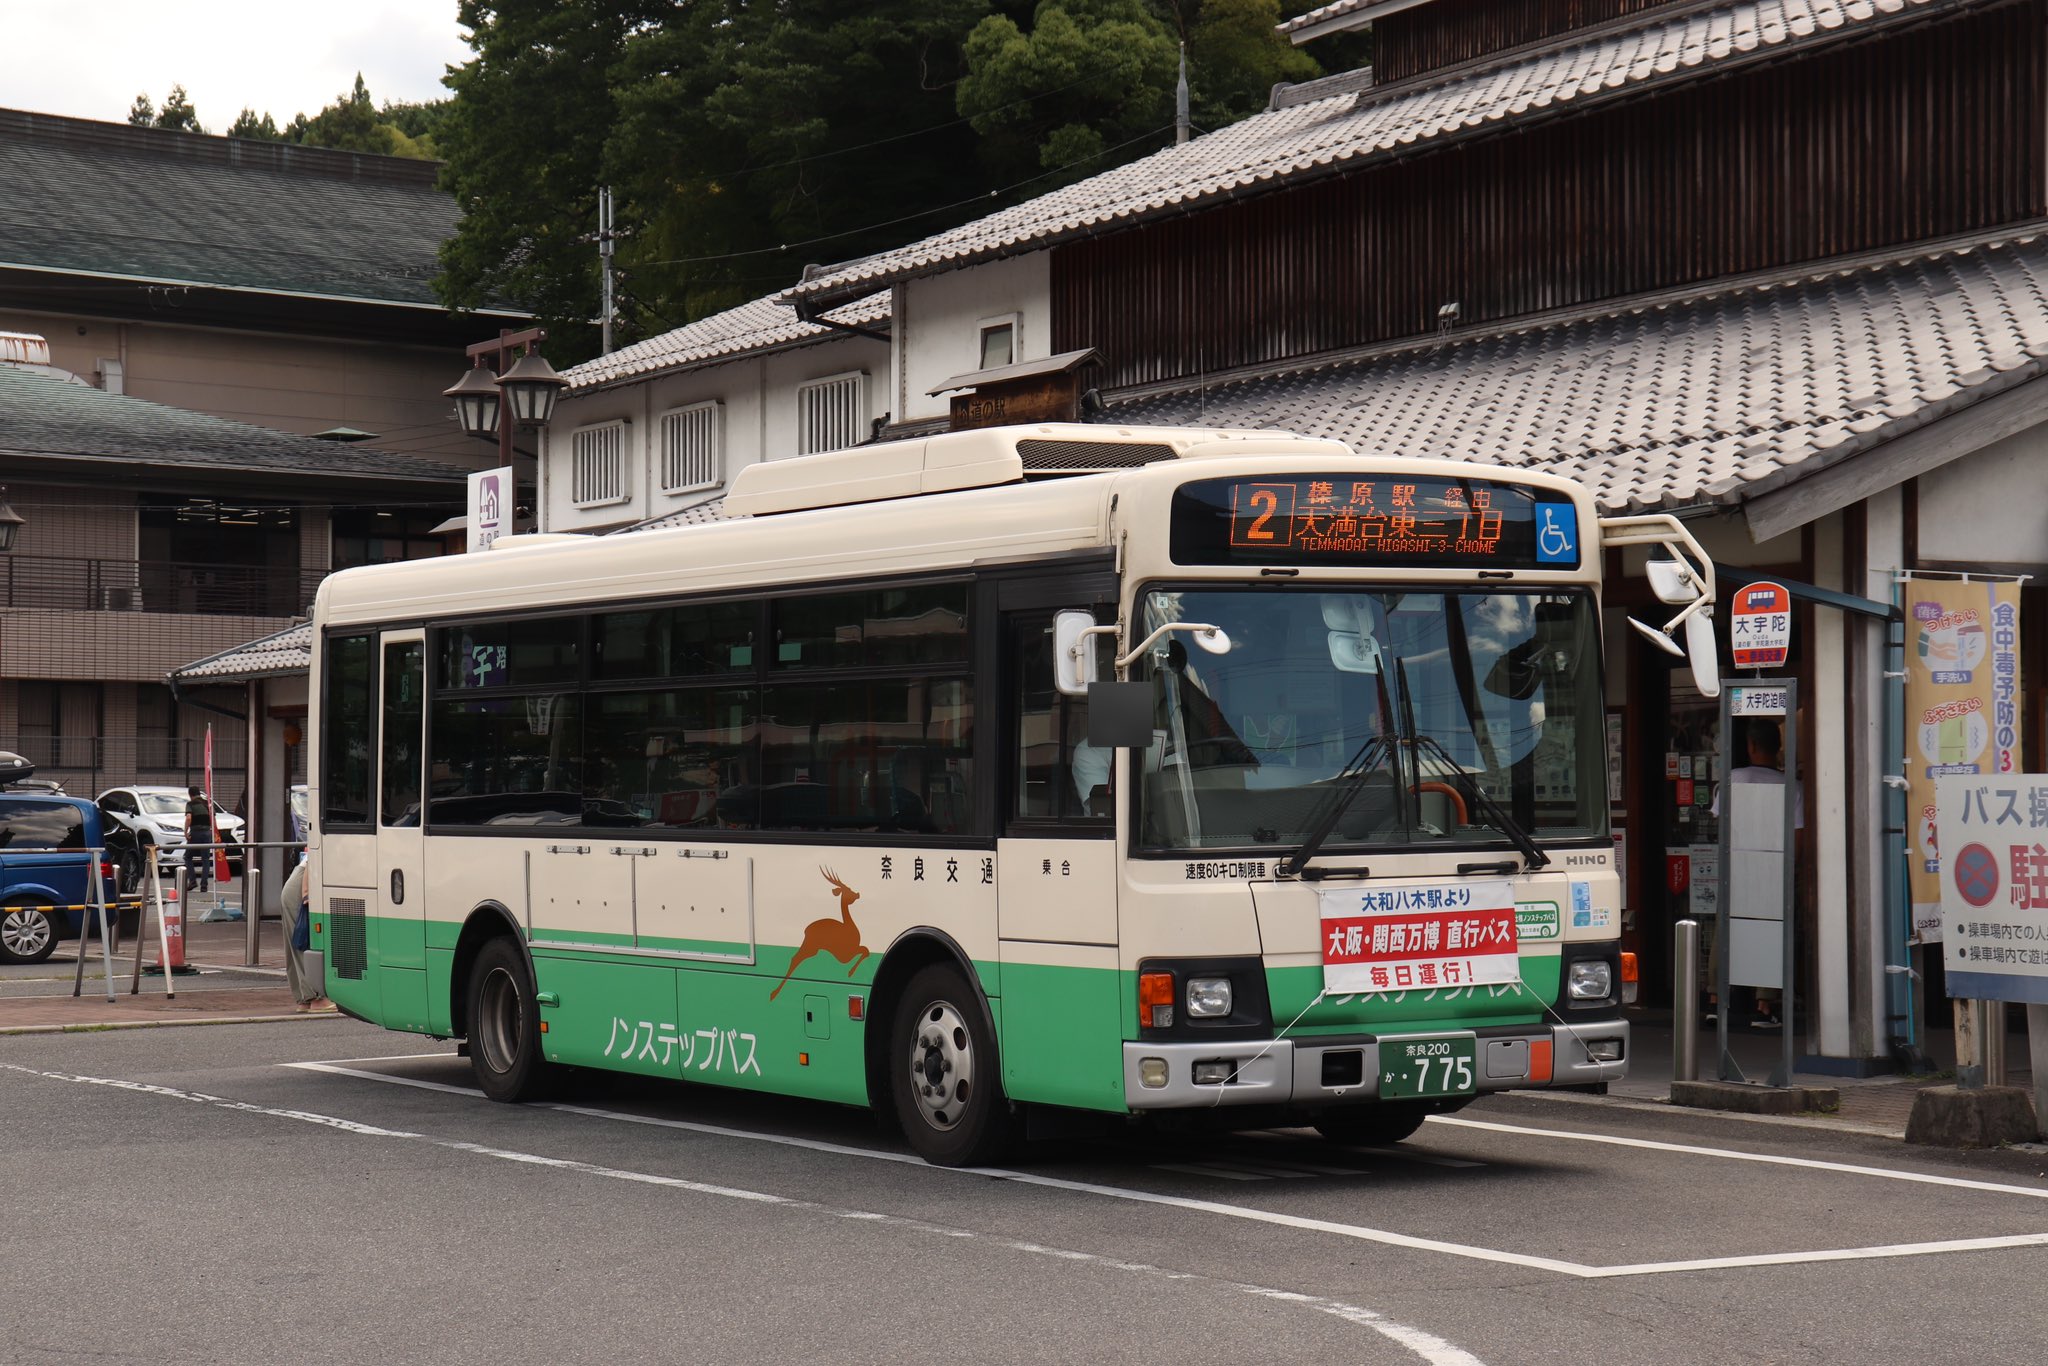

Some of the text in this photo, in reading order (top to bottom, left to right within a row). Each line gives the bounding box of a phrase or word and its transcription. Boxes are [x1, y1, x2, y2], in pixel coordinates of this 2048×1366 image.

[971, 397, 1006, 423] 道の駅
[1444, 488, 1491, 508] 経由
[1247, 489, 1277, 539] 2
[1296, 506, 1503, 540] 天満台東三丁目
[1301, 537, 1497, 554] TEMMADAI-HIGASHI-3-CHOME
[1736, 616, 1786, 634] 大宇陀
[1926, 609, 1978, 631] つけない
[1936, 672, 1967, 683] 手洗い
[1746, 692, 1786, 708] 大宇陀迫間
[1923, 697, 1982, 725] ふやさない
[881, 855, 993, 884] 奈良交通
[1042, 859, 1070, 876] 乗合
[1185, 862, 1266, 879] 速度60キロ制限車
[1566, 854, 1607, 866] HINO
[1362, 888, 1471, 912] 大和八木駅より
[1328, 917, 1511, 957] 大阪・関西万博 直行バス
[1968, 921, 2048, 941] 操車場内での人
[604, 1016, 761, 1077] ノンステップバス
